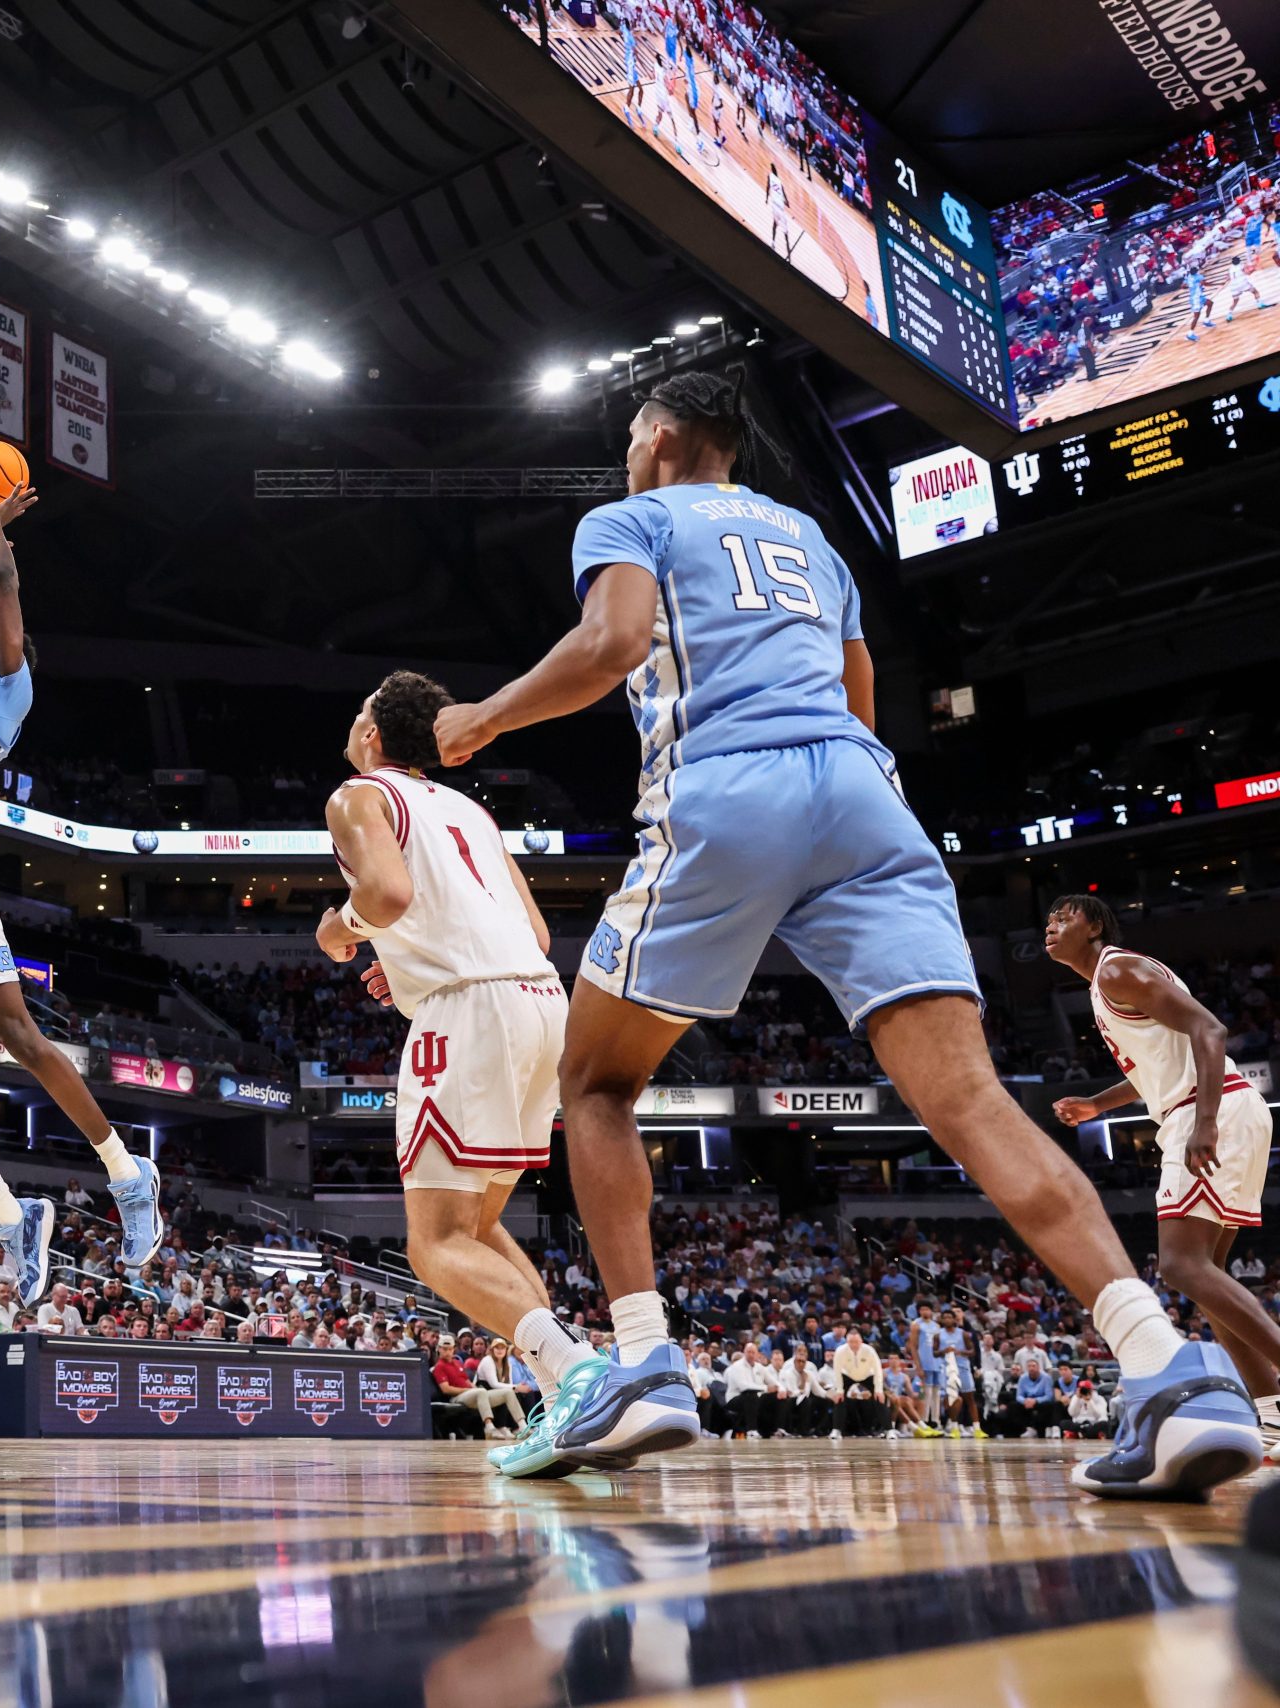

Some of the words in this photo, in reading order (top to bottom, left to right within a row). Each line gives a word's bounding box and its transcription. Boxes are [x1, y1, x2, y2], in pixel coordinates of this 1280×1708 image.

[63, 347, 96, 377] WNBA
[60, 369, 99, 397] EASTERN
[56, 395, 105, 426] CHAMPIONS
[68, 419, 92, 441] 2015
[1115, 417, 1155, 436] 3-POINT
[1155, 414, 1169, 426] FG
[1061, 460, 1075, 472] 19
[1109, 426, 1162, 450] REBOUNDS
[1162, 418, 1189, 435] (OFF)
[1211, 413, 1226, 425] 11
[1227, 408, 1244, 421] (3)
[1073, 472, 1082, 483] 3
[1130, 436, 1171, 456] ASSISTS
[1225, 425, 1235, 436] 5
[1075, 486, 1084, 495] 7
[1133, 448, 1172, 467] BLOCKS
[1228, 439, 1238, 449] 4
[1125, 457, 1184, 481] TURNOVERS
[912, 457, 978, 504] INDIANA
[690, 499, 801, 541] STEVENSON
[720, 533, 822, 620] 15
[943, 839, 961, 852] 19
[1116, 812, 1127, 825] 4
[1171, 801, 1183, 815] 4
[204, 835, 240, 850] INDIANA
[238, 1083, 292, 1105] salesforce
[342, 1091, 398, 1110] IndyS
[792, 1093, 863, 1111] DEEM
[58, 1370, 81, 1381] BAD
[93, 1371, 117, 1382] BOY
[140, 1373, 163, 1384] BAD
[173, 1374, 196, 1384] BOY
[220, 1376, 240, 1386] BAD
[249, 1377, 270, 1387] BOY
[295, 1378, 315, 1388] BAD
[323, 1379, 343, 1389] BOY
[360, 1381, 379, 1390] BAD
[387, 1381, 405, 1391] BOY
[63, 1383, 112, 1393] MOWERS
[145, 1386, 191, 1395] MOWERS
[223, 1388, 266, 1397] MOWERS
[299, 1390, 339, 1399] MOWERS
[364, 1391, 402, 1400] MOWERS
